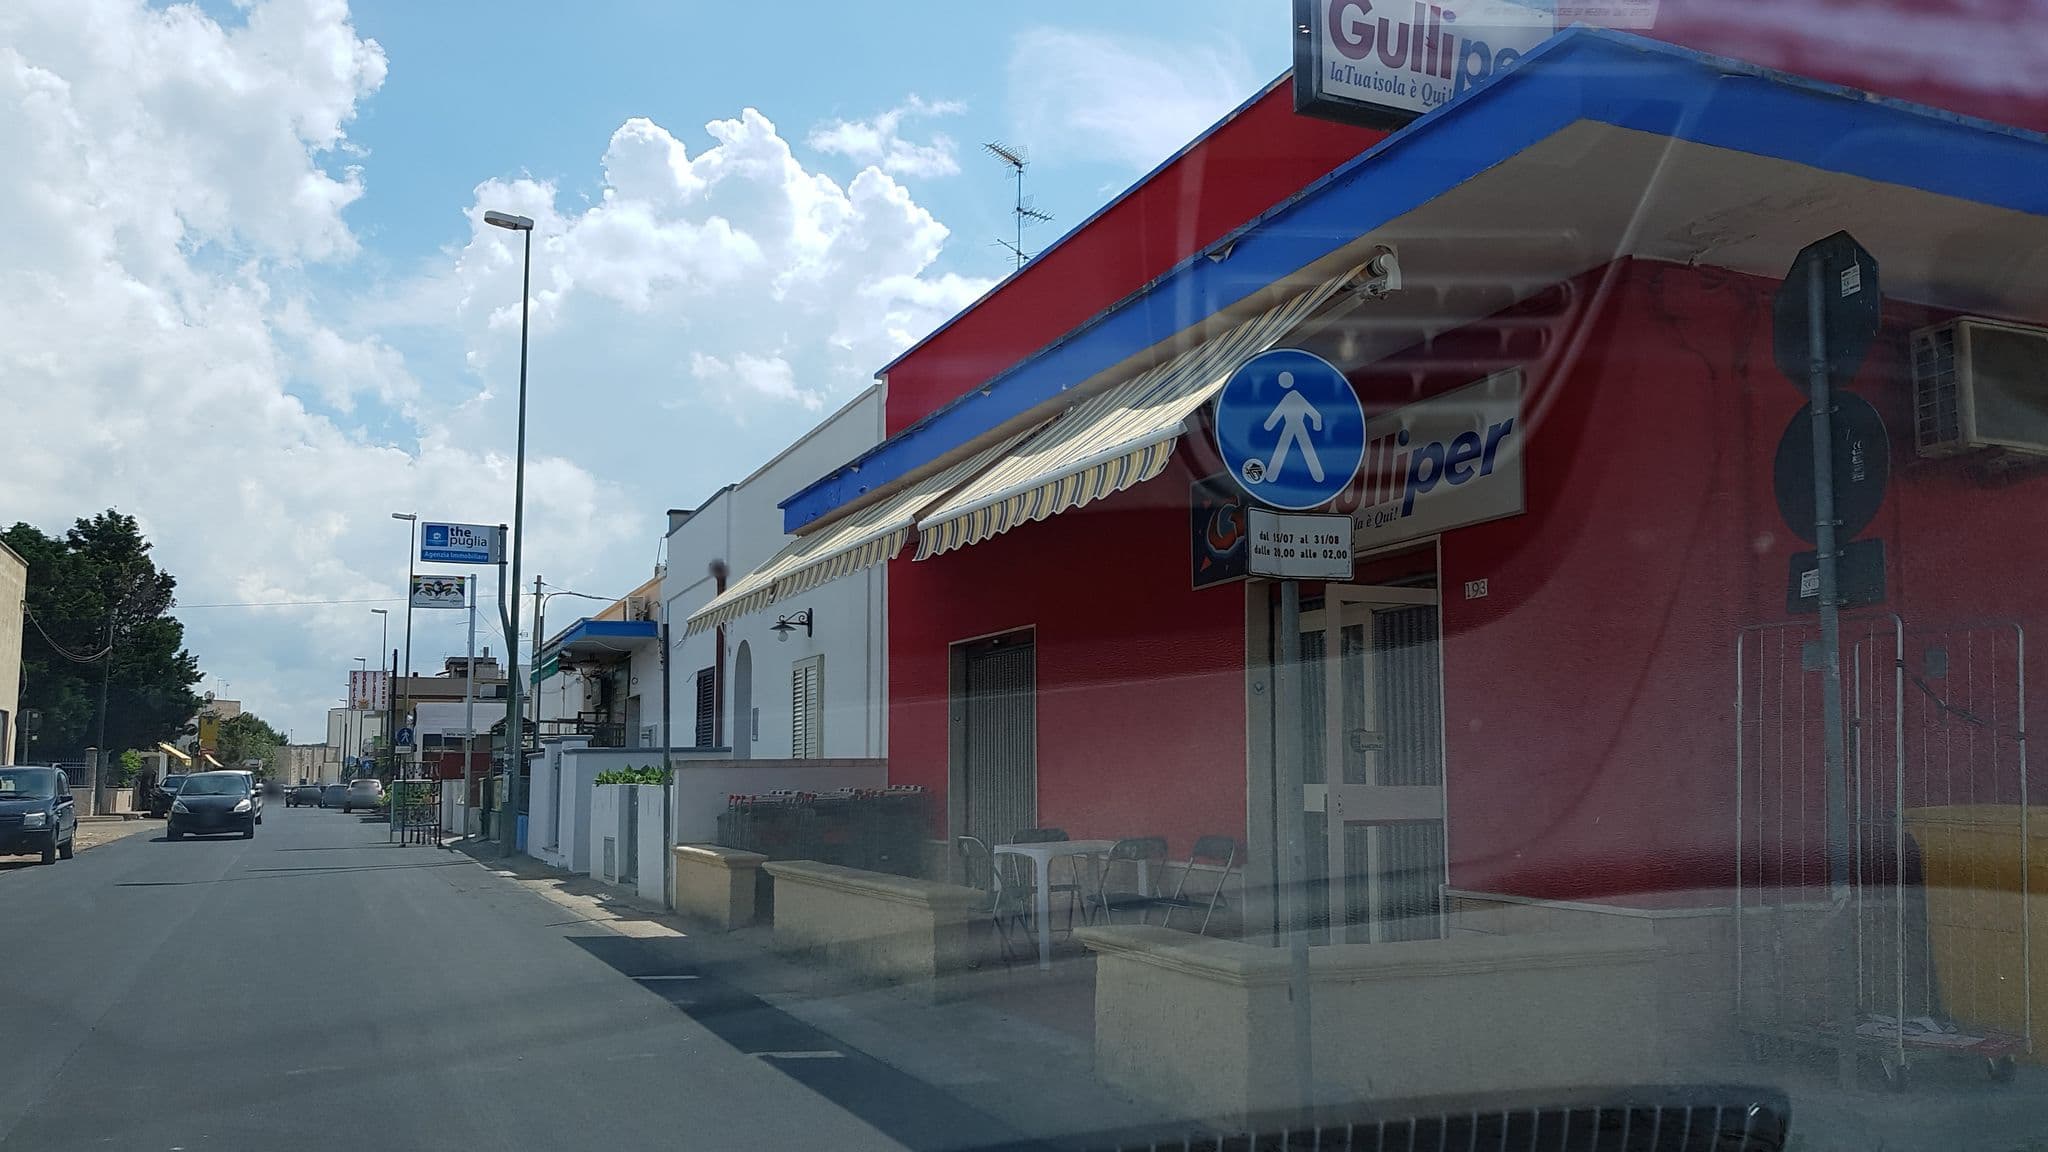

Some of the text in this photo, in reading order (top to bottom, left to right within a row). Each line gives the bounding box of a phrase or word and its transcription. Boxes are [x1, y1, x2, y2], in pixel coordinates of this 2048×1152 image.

[1328, 0, 1522, 92] Gullip
[1410, 79, 1417, 99] è
[1313, 417, 1513, 518] ulliper
[1374, 507, 1398, 529] Qui!
[449, 526, 471, 537] the
[1259, 530, 1269, 541] dal
[1300, 534, 1308, 544] al
[1314, 534, 1340, 545] 31/08
[449, 536, 487, 549] puglia
[424, 551, 487, 560] Agenzia Immobiliare
[1254, 544, 1270, 556] dalle
[1300, 548, 1317, 559] alle
[1322, 549, 1348, 560] 02.00
[1465, 581, 1486, 598] 193
